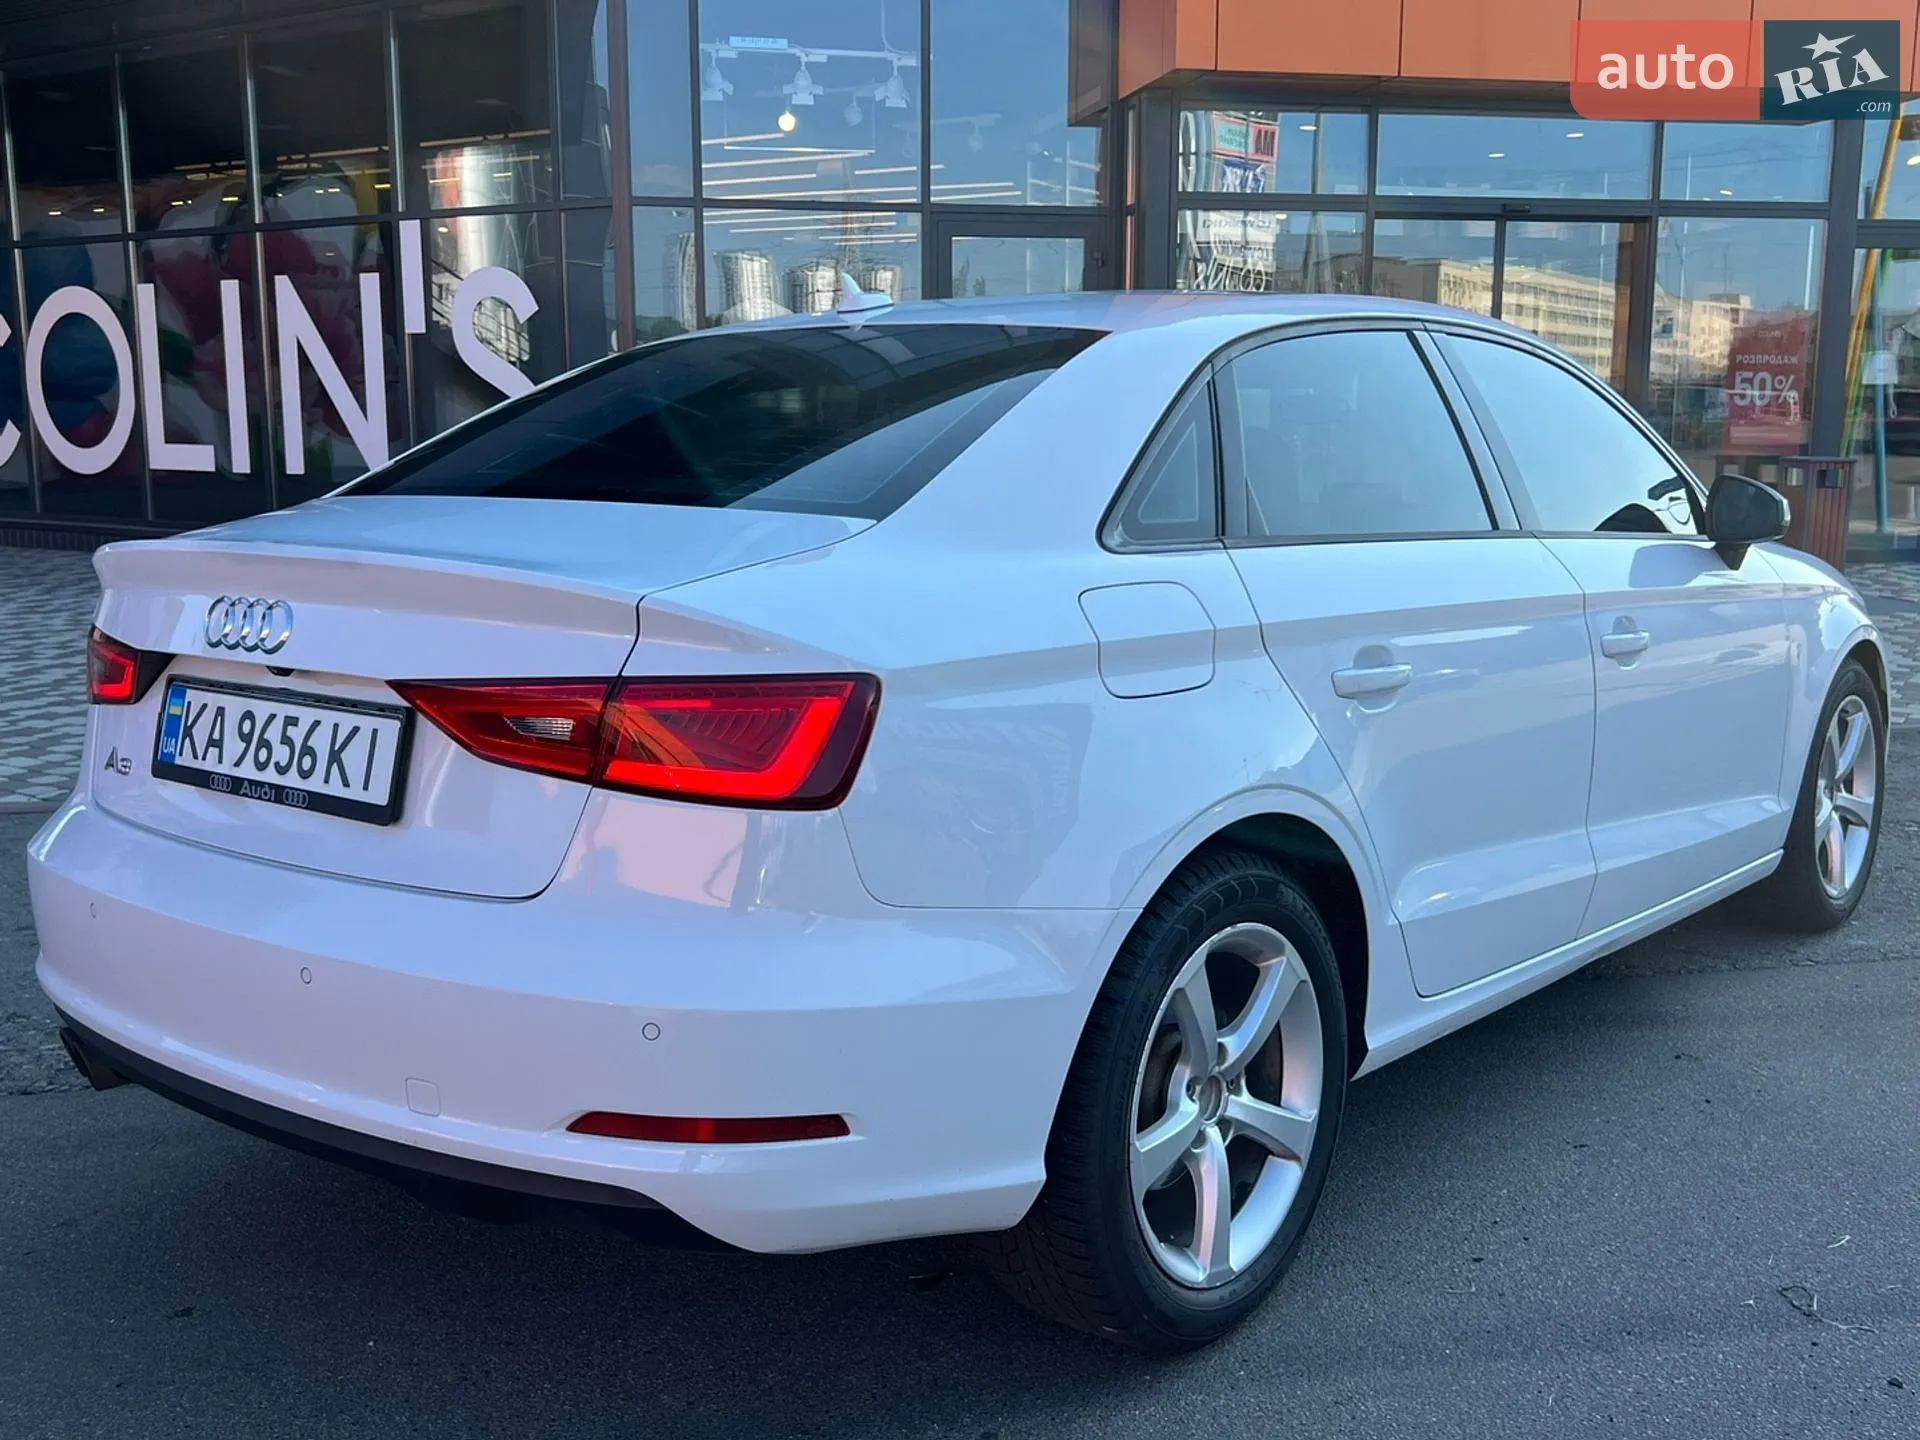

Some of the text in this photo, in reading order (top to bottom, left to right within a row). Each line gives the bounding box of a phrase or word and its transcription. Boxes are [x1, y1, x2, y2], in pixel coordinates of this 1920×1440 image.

[0, 220, 539, 475] OLIN'S
[1736, 353, 1799, 366] РОЗПРОДАЖ
[1734, 371, 1796, 407] 50%
[162, 736, 176, 754] UA
[104, 744, 132, 776] A3
[239, 780, 276, 802] Audi
